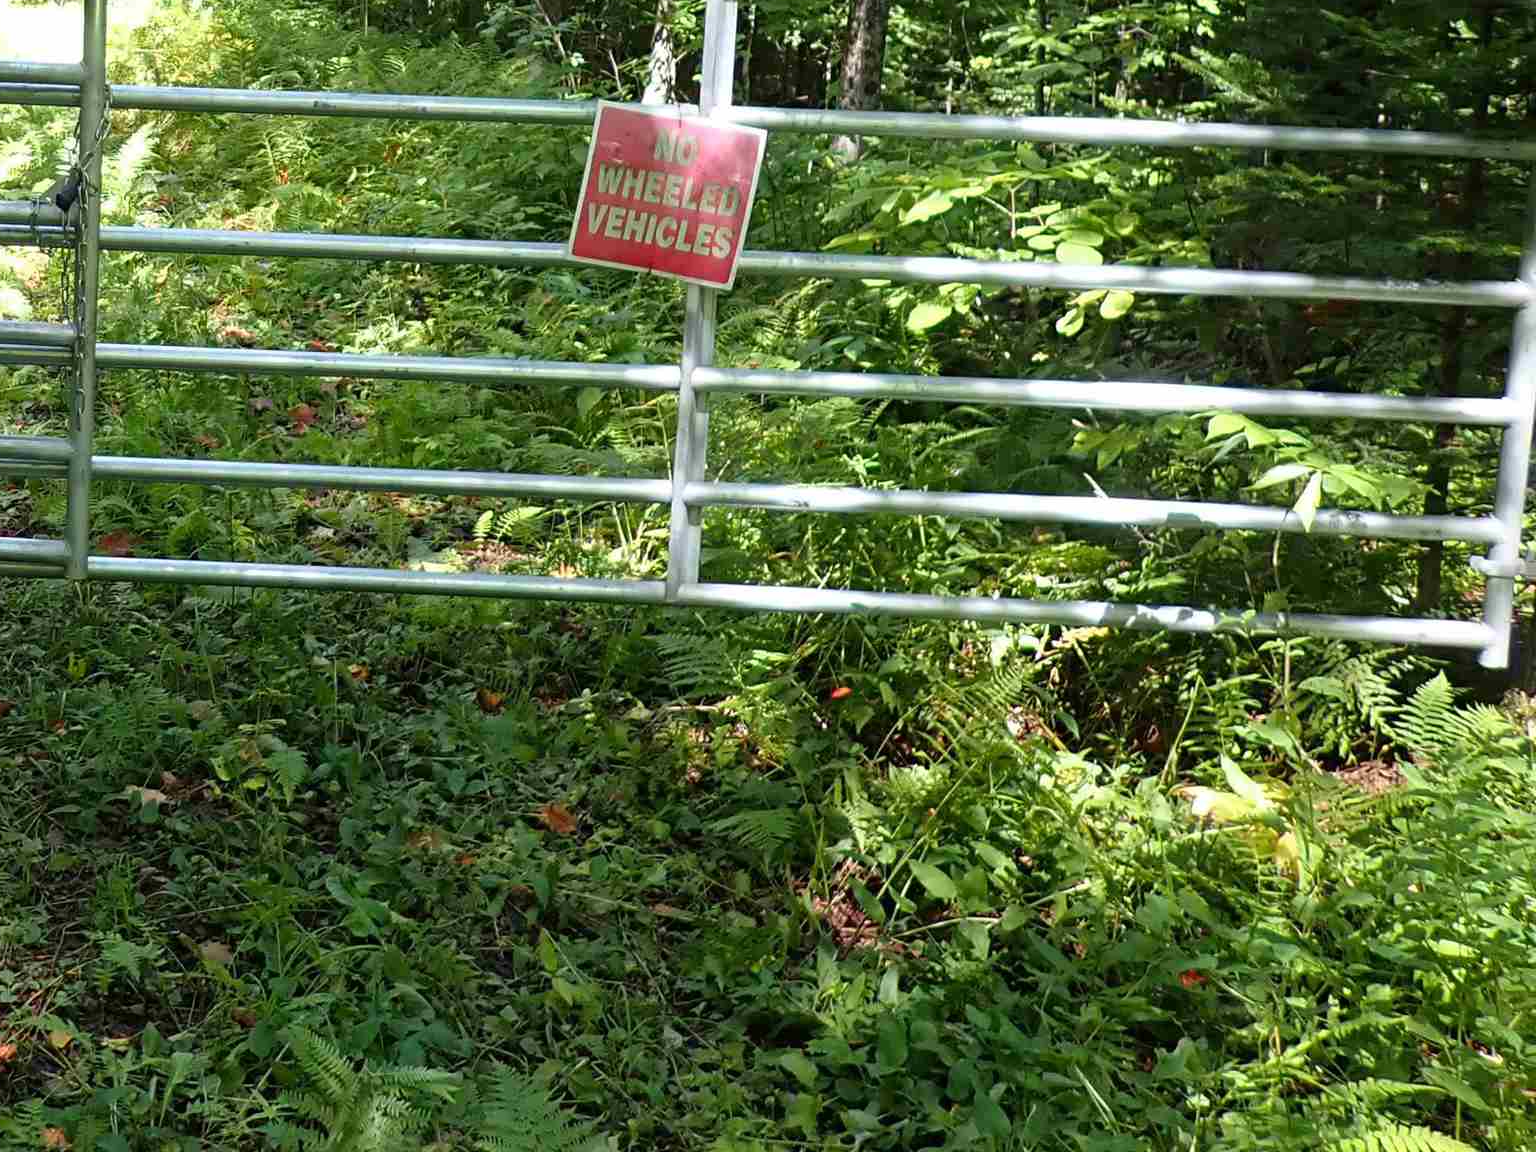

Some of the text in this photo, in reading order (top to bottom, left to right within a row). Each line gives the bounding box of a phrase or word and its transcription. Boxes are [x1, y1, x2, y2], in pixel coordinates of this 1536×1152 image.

[654, 127, 699, 166] NO
[597, 162, 741, 217] WHEELED
[587, 202, 734, 259] VEHICLES
